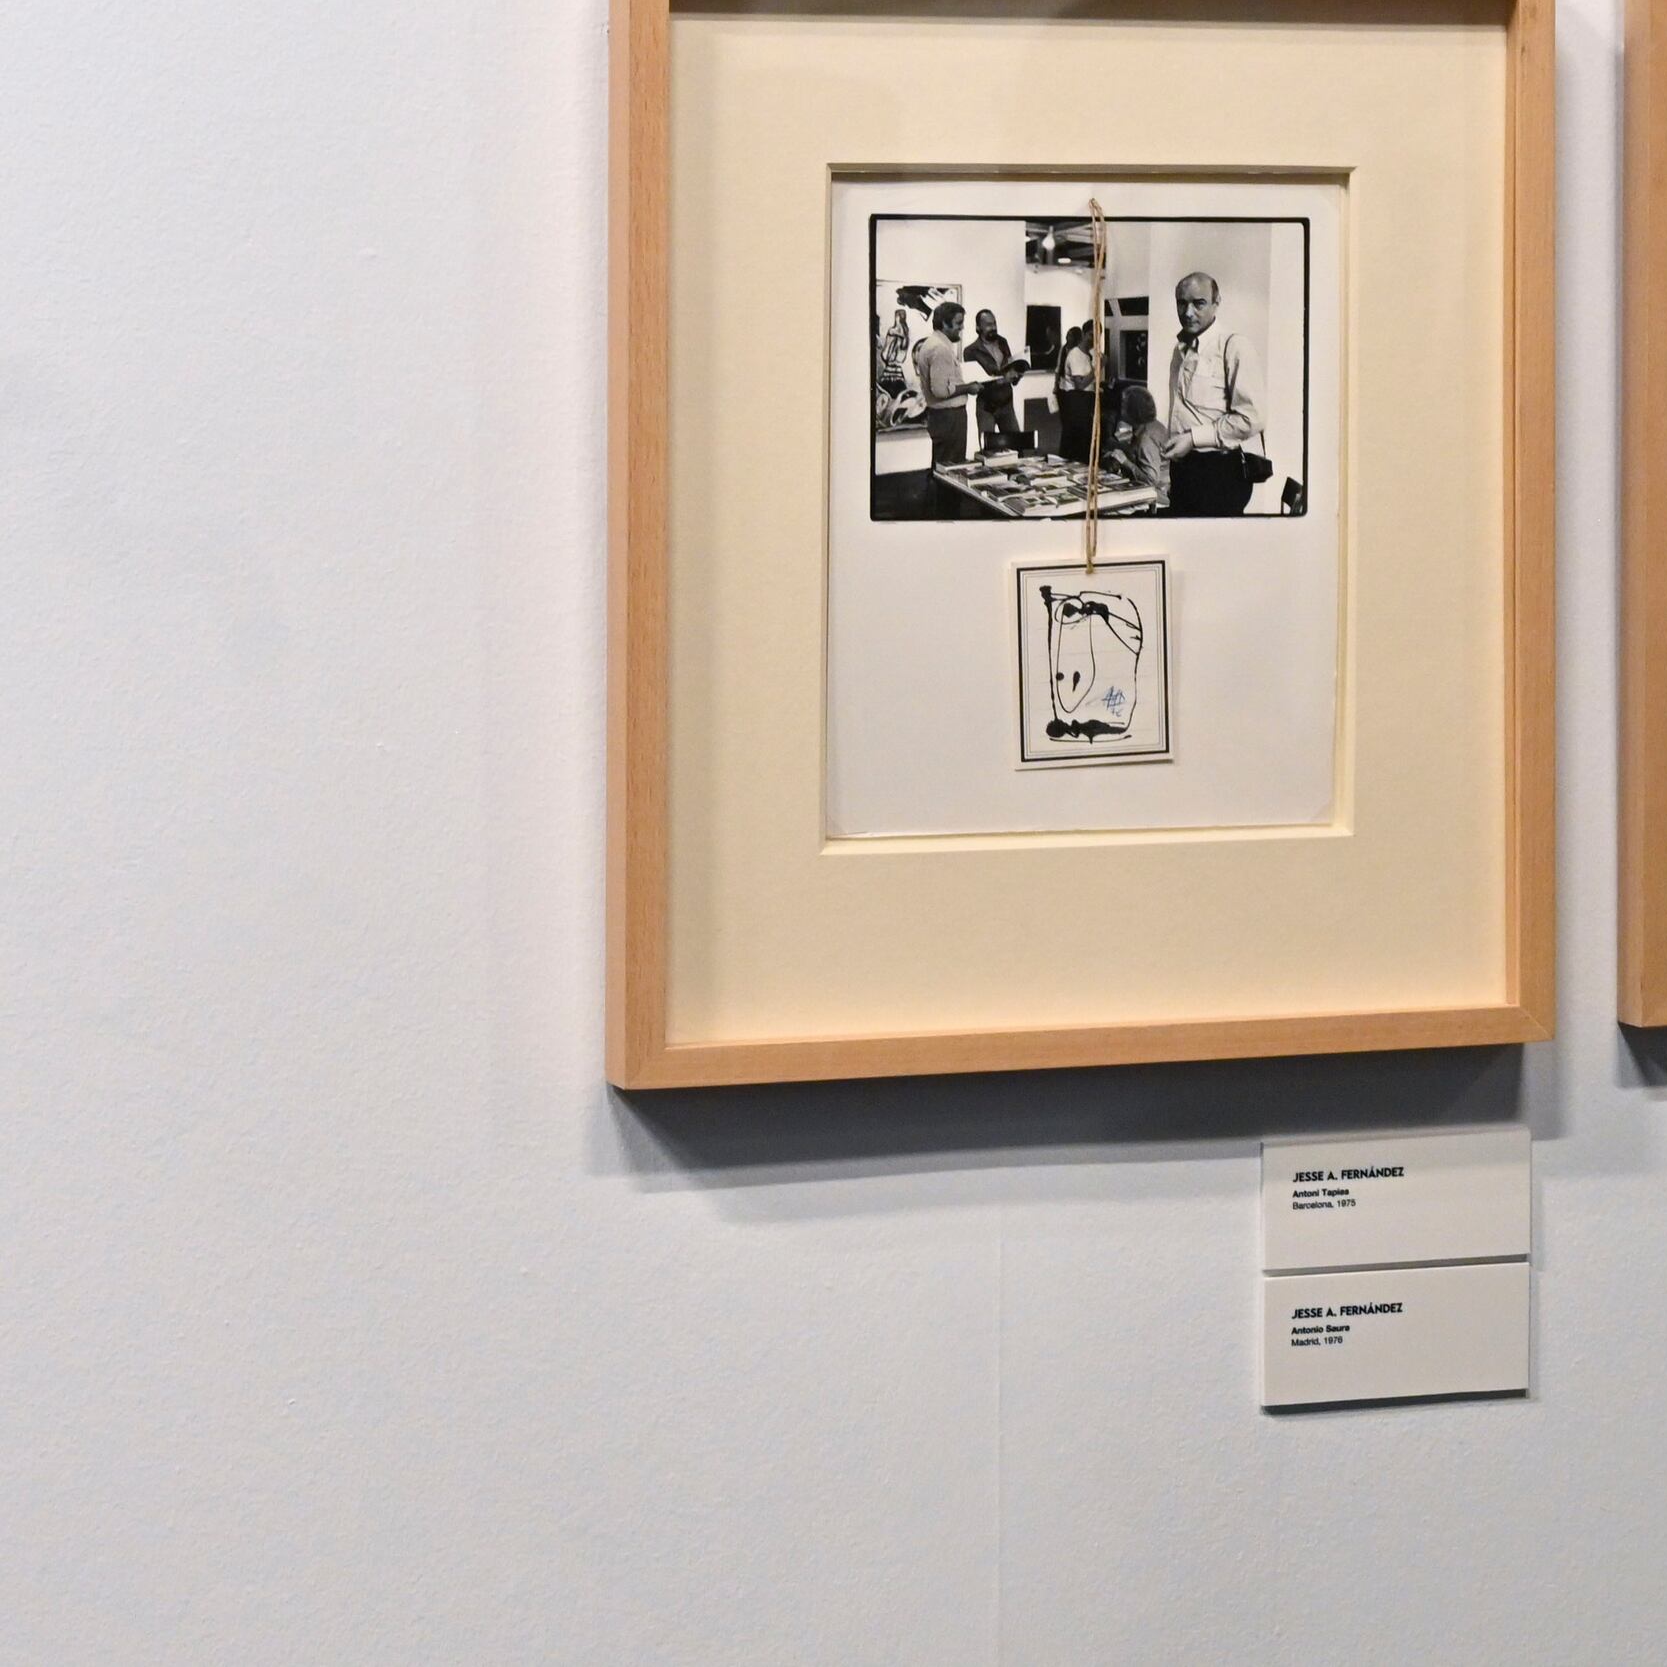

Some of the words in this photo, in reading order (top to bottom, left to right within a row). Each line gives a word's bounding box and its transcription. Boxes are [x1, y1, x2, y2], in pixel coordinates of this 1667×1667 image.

[1292, 1170, 1325, 1183] JESSE
[1326, 1170, 1338, 1181] A.
[1340, 1165, 1405, 1180] FERNÁNDEZ
[1292, 1189, 1320, 1198] Antoni
[1292, 1200, 1334, 1210] Barcelona,
[1336, 1198, 1357, 1208] 1975
[1291, 1307, 1323, 1320] JESSE
[1326, 1306, 1337, 1318] A.
[1339, 1301, 1404, 1316] FERNÁNDEZ
[1291, 1326, 1324, 1336] Antonio
[1325, 1324, 1351, 1334] Saura
[1291, 1337, 1322, 1347] Madrid,
